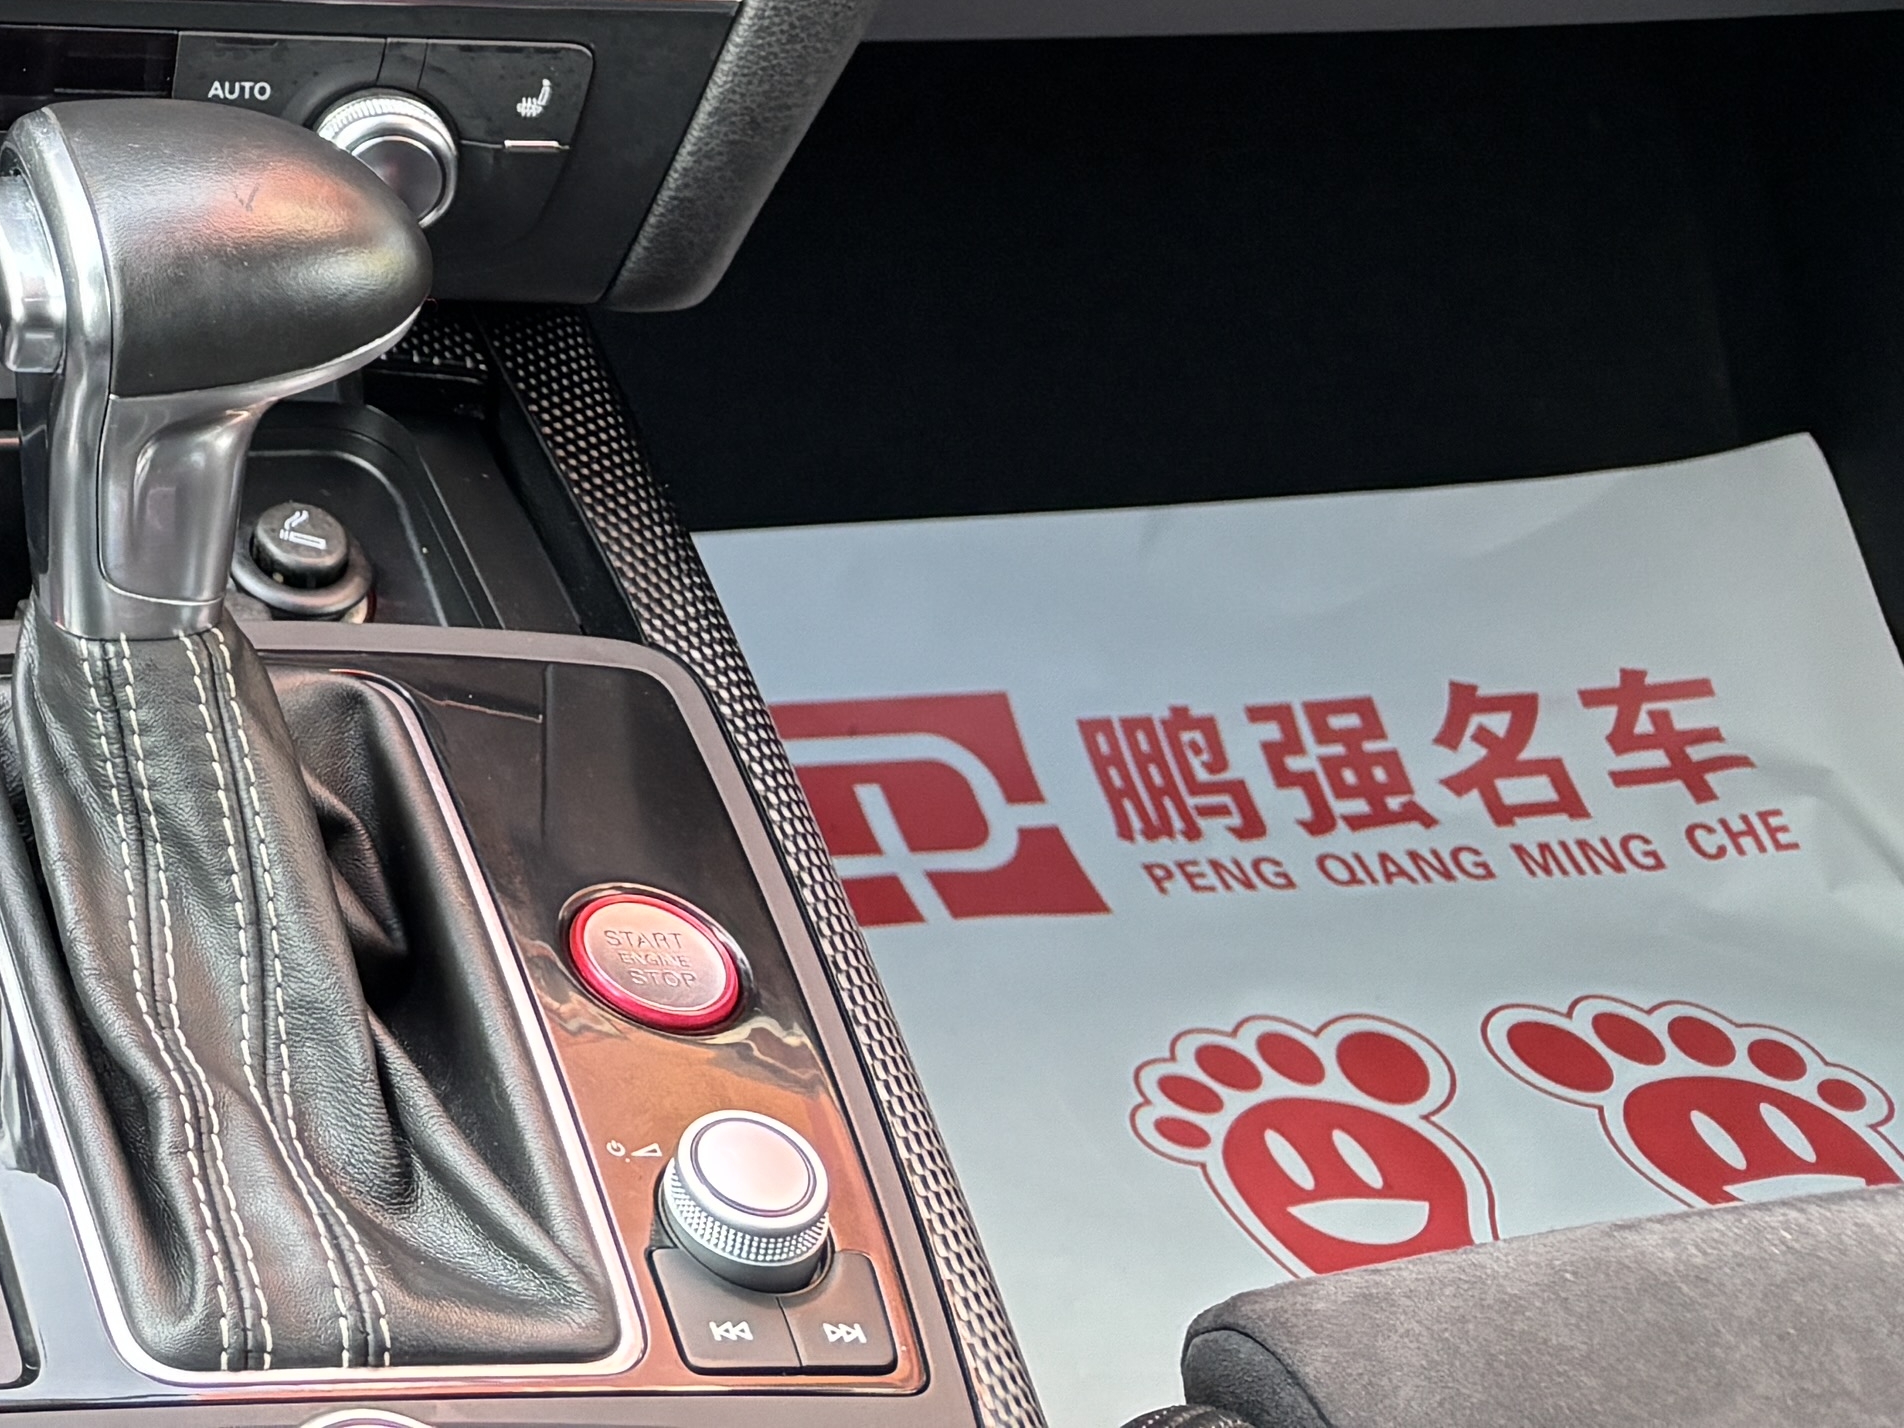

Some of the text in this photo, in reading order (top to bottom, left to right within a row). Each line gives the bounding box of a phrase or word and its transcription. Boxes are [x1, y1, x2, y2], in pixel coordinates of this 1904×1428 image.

[207, 79, 272, 101] AUTO
[1076, 668, 1756, 844] 鹏强名车
[1142, 807, 1801, 896] PENG QIANG MING CHE
[603, 929, 683, 950] START
[618, 951, 691, 968] ENGINE
[629, 968, 698, 988] STOP
